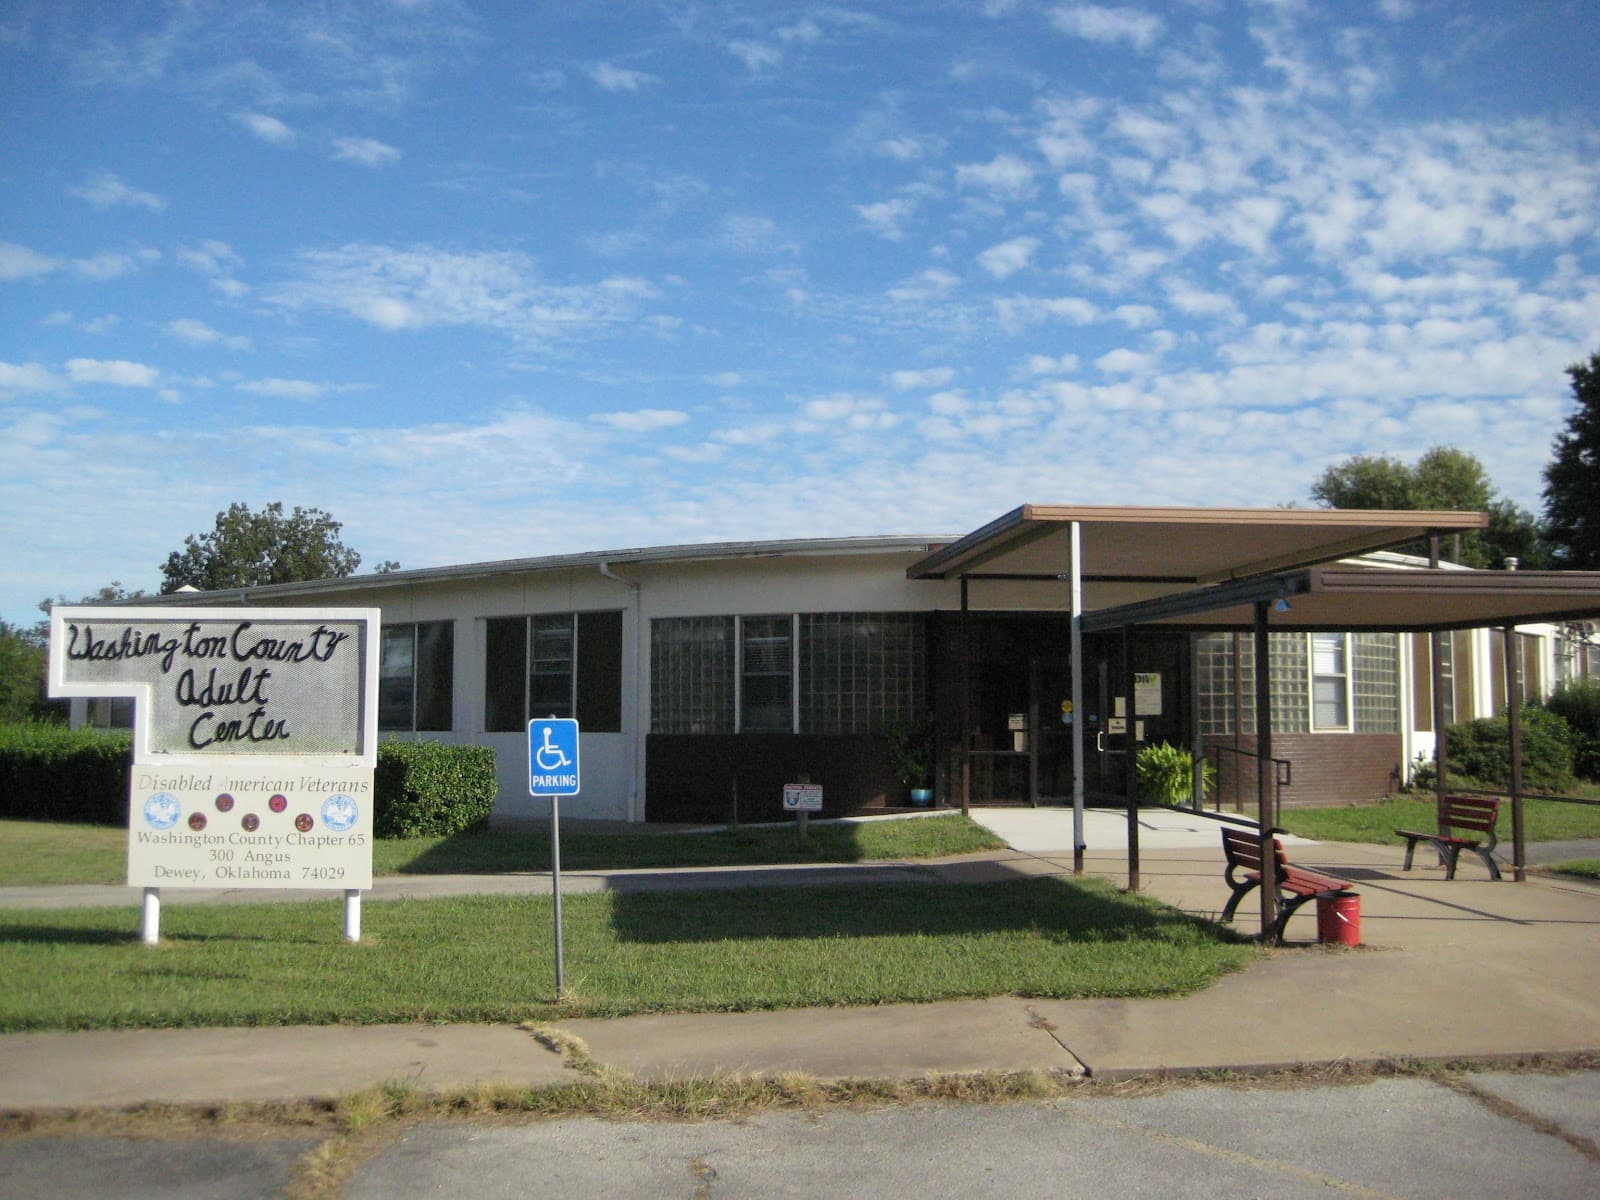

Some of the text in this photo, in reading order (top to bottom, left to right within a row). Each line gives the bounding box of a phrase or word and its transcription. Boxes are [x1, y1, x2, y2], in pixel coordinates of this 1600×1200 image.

[68, 621, 349, 673] Washington County
[176, 667, 271, 708] Adult
[189, 706, 290, 749] Center
[138, 775, 213, 792] Disabled
[299, 776, 369, 793] Veterans
[532, 775, 577, 788] PARKING
[137, 832, 366, 849] Washington County Chapter 65
[208, 850, 292, 866] 300 Angus
[153, 865, 345, 880] Dewey, Oklahoma 74029
